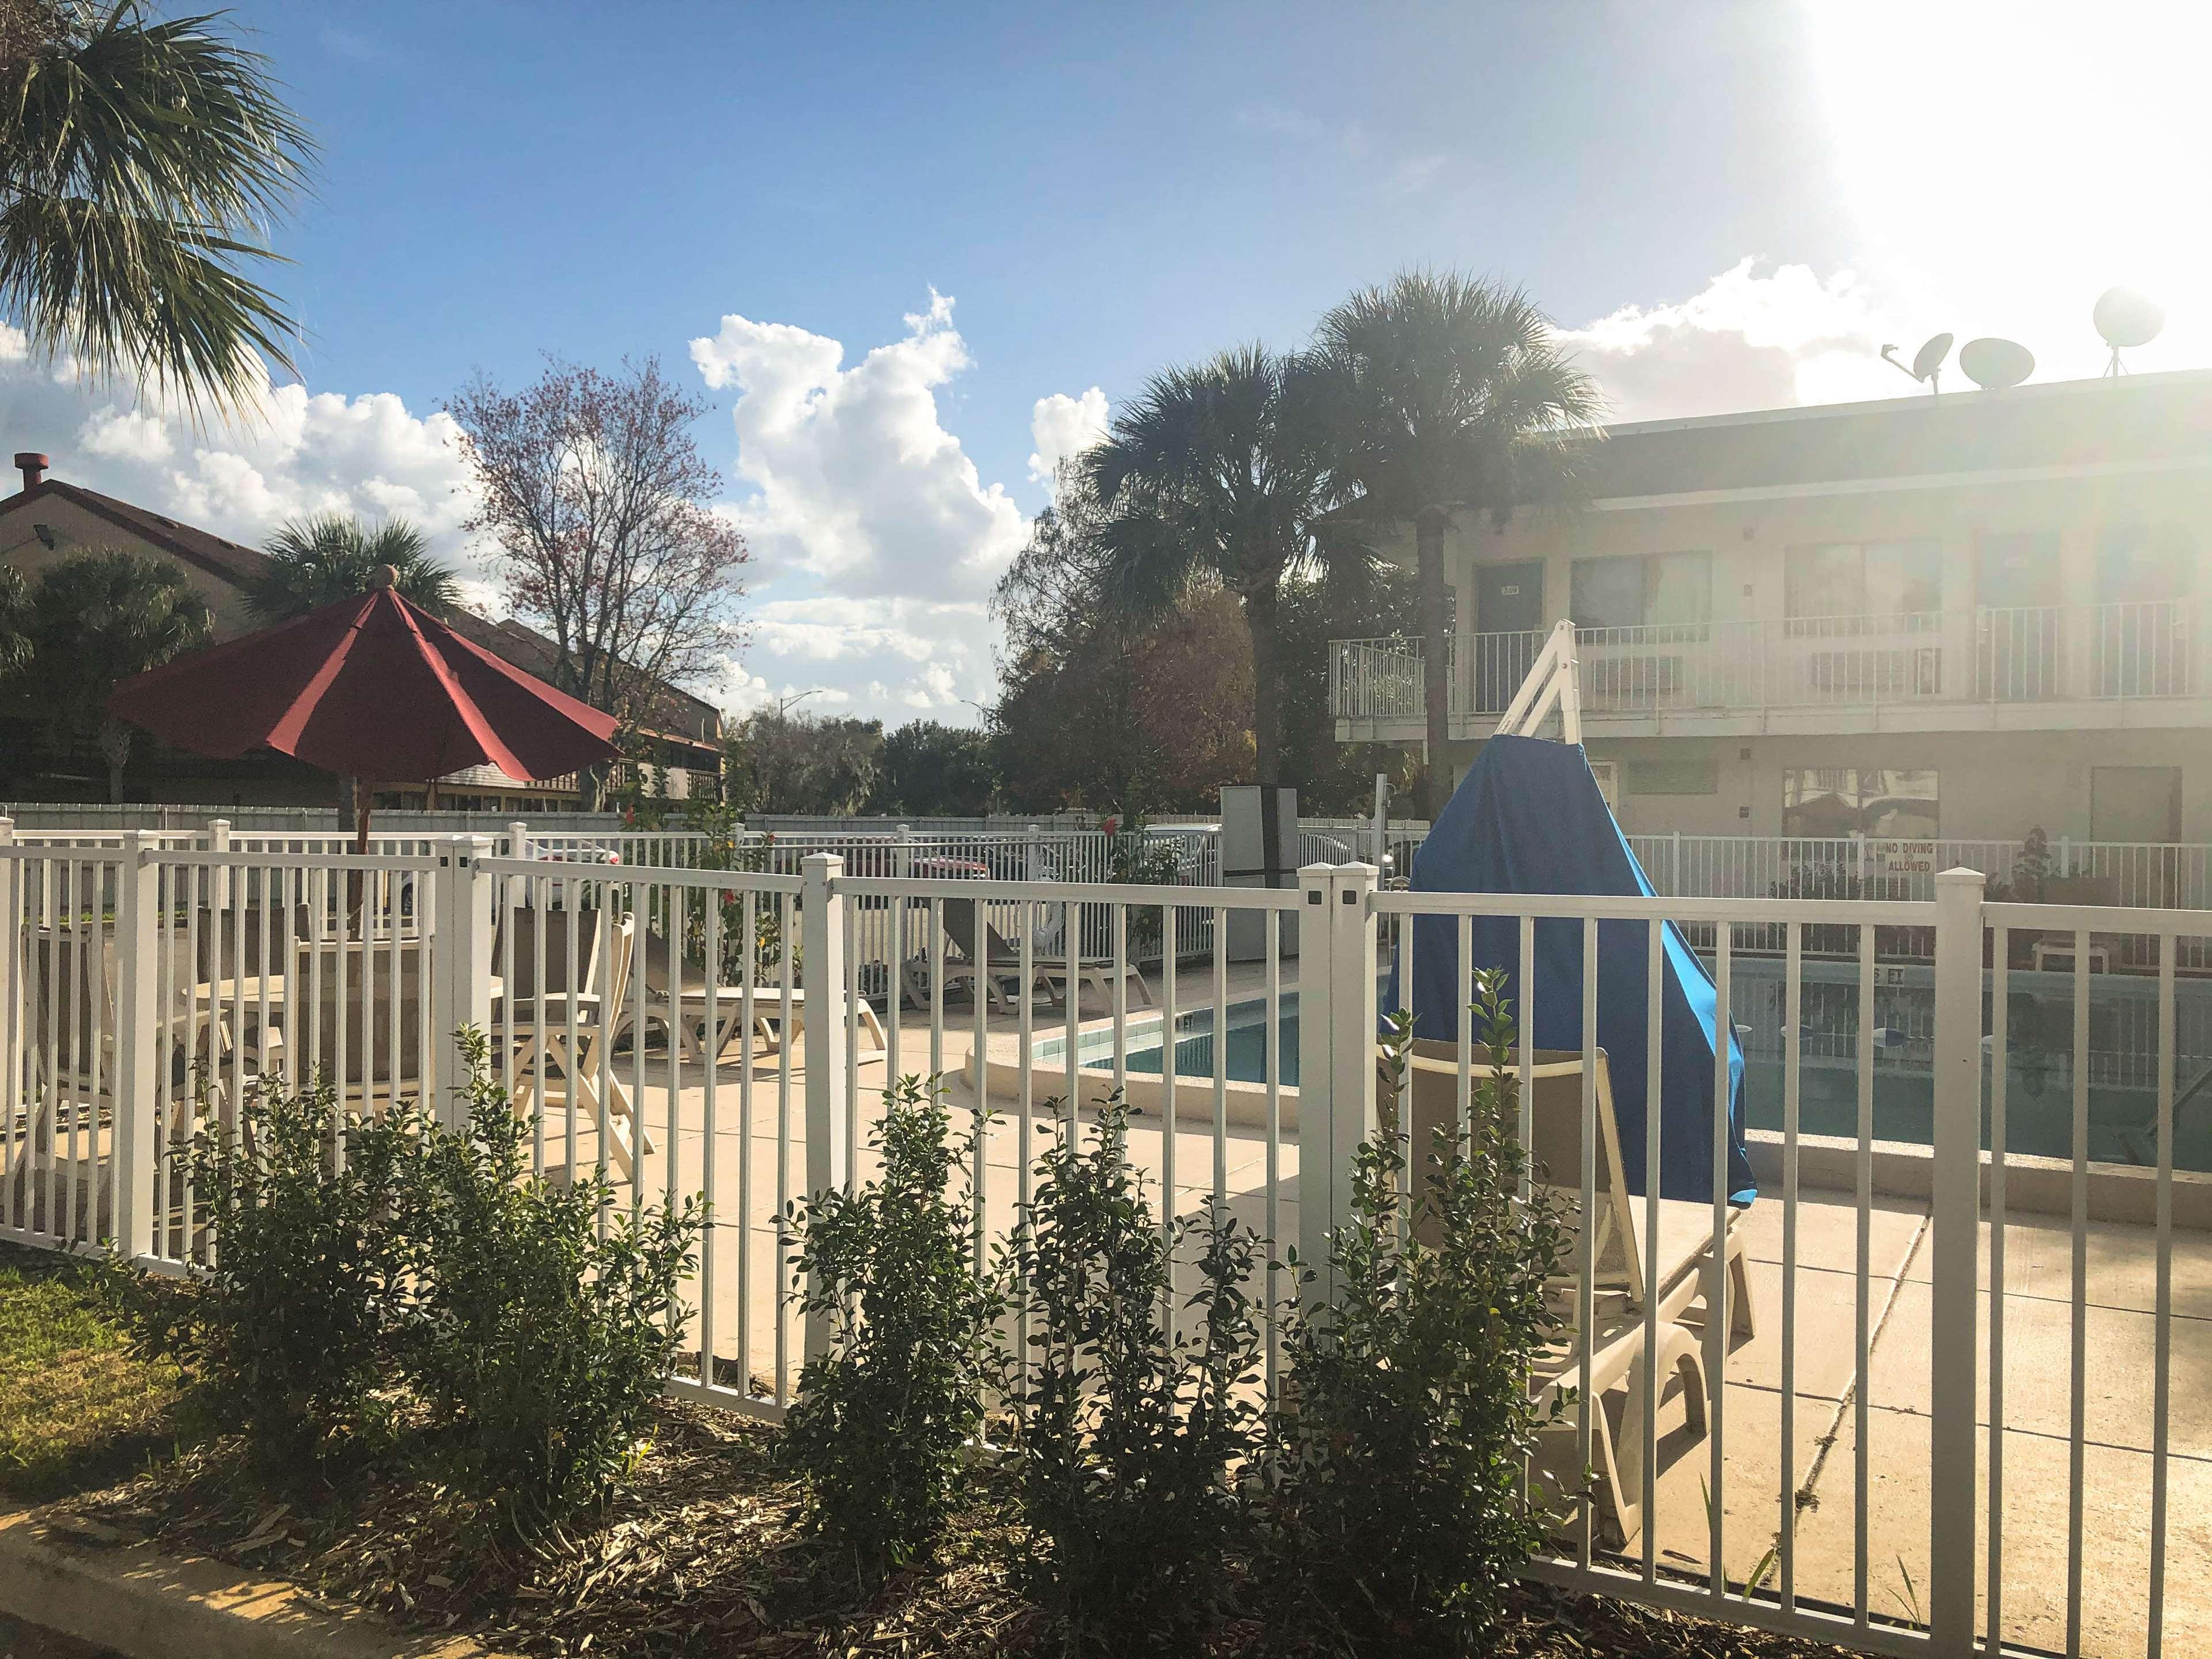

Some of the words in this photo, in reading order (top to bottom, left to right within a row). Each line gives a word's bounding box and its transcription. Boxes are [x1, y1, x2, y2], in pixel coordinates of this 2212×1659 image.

[1885, 843, 1898, 853] NO
[1903, 843, 1933, 853] DIVING
[1889, 861, 1930, 872] ALLOWED
